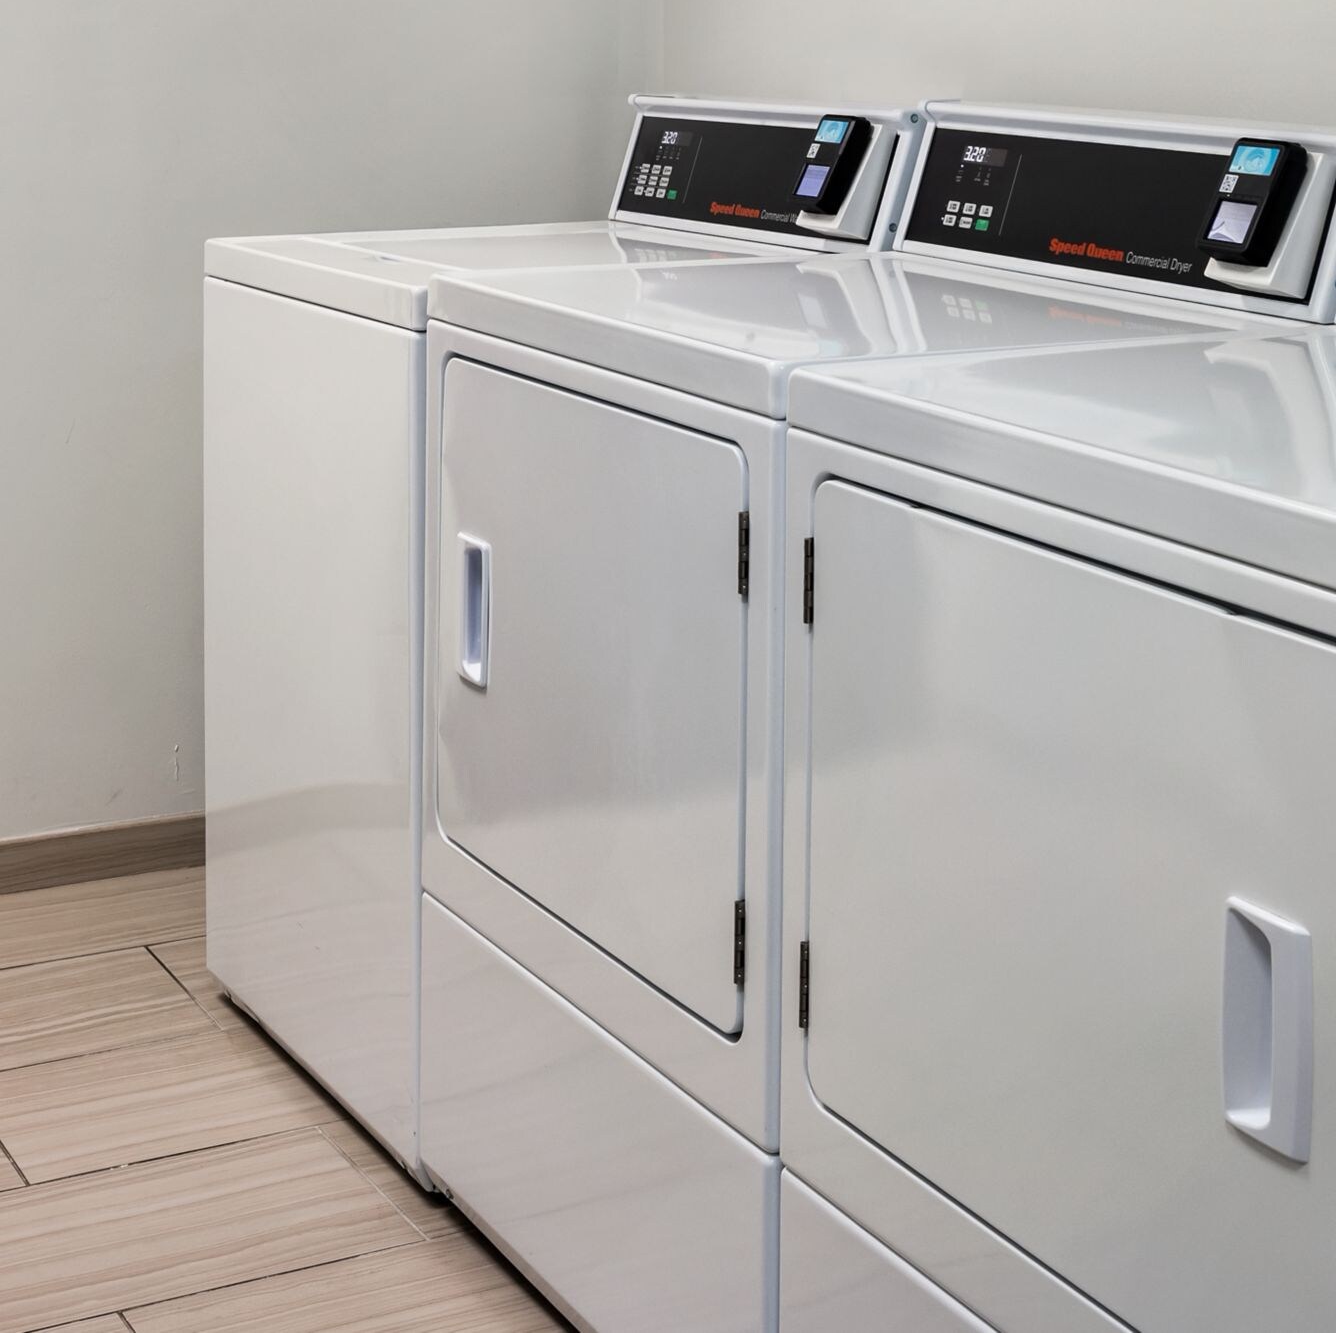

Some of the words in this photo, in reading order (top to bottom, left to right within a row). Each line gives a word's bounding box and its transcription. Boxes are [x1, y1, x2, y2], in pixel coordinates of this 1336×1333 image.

[709, 201, 736, 216] Speed
[735, 205, 761, 219] Queen
[760, 209, 790, 223] Commercial
[1049, 238, 1087, 256] Speed
[1086, 243, 1125, 263] Queen
[1125, 251, 1171, 268] Commercial
[1169, 257, 1193, 275] Dryer
